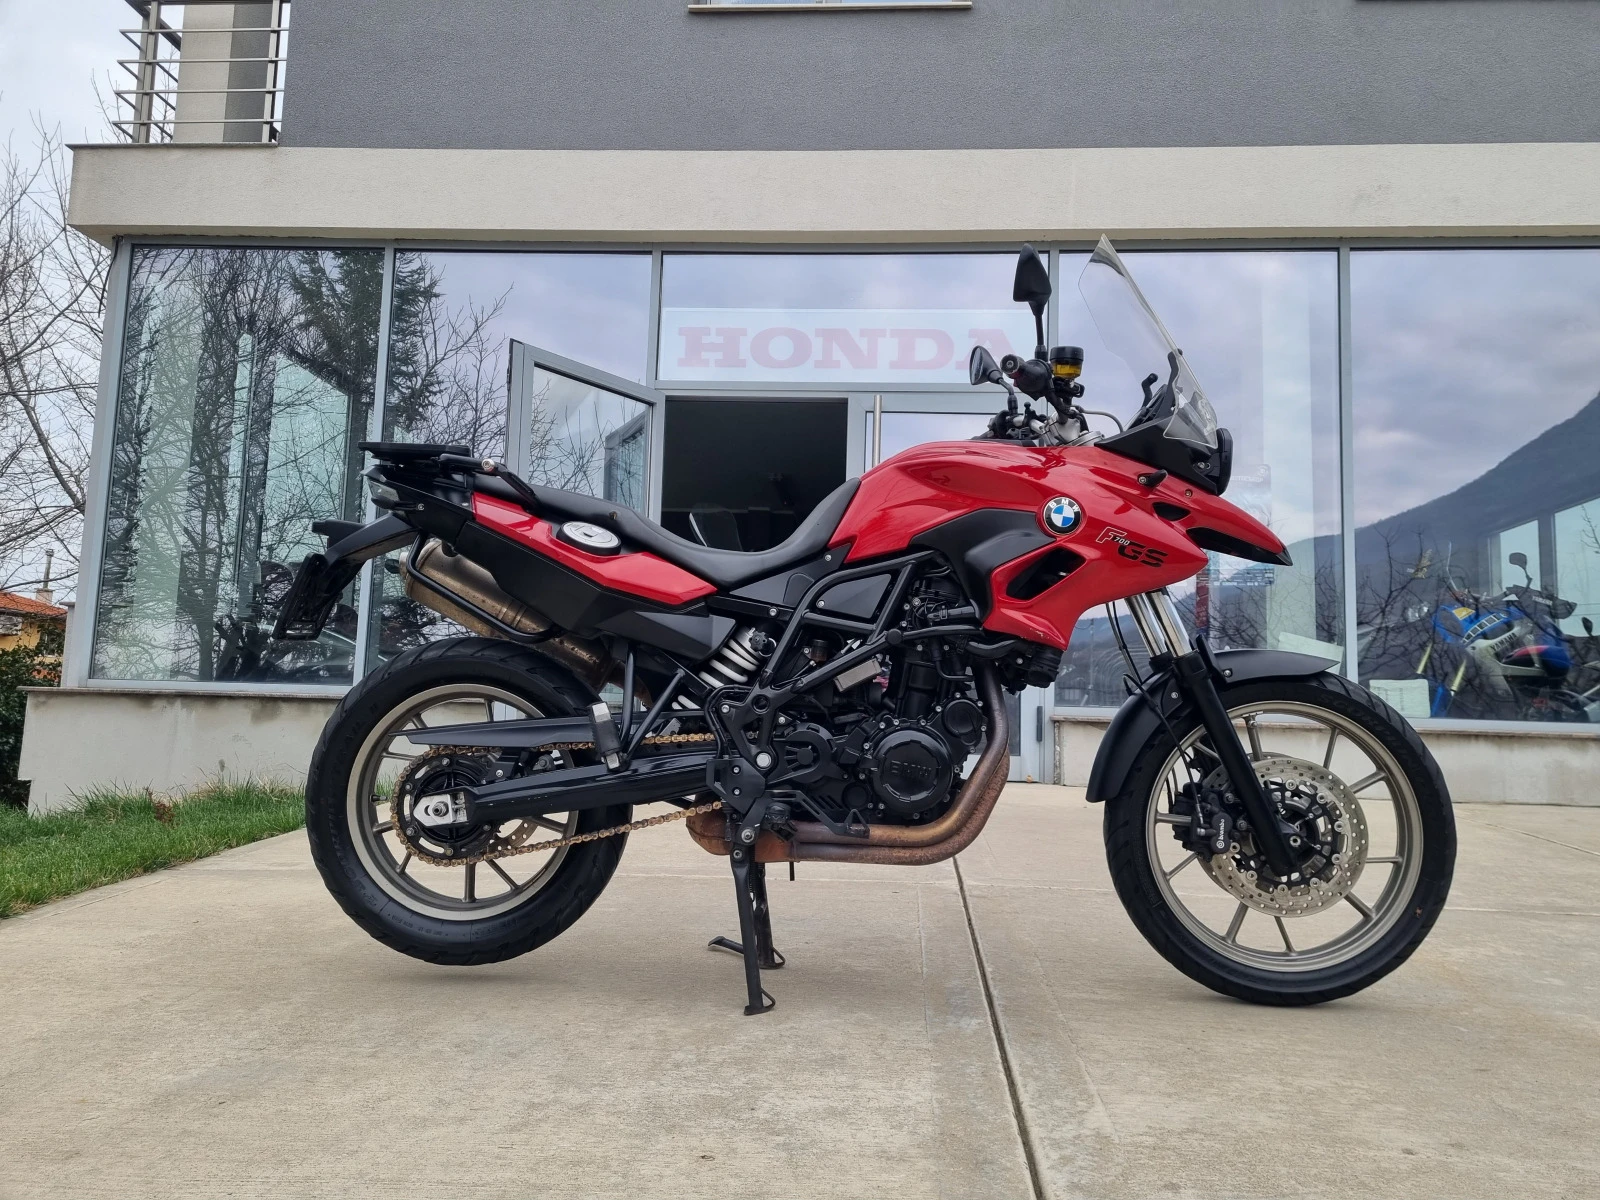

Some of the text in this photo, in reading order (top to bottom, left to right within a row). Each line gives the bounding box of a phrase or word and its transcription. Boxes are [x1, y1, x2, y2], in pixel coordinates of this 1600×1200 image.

[677, 326, 1018, 370] HONDA
[1050, 498, 1081, 512] BMW
[1096, 527, 1168, 567] F 700 GS
[1490, 632, 1517, 651] YAMAHA
[891, 760, 932, 777] BMW
